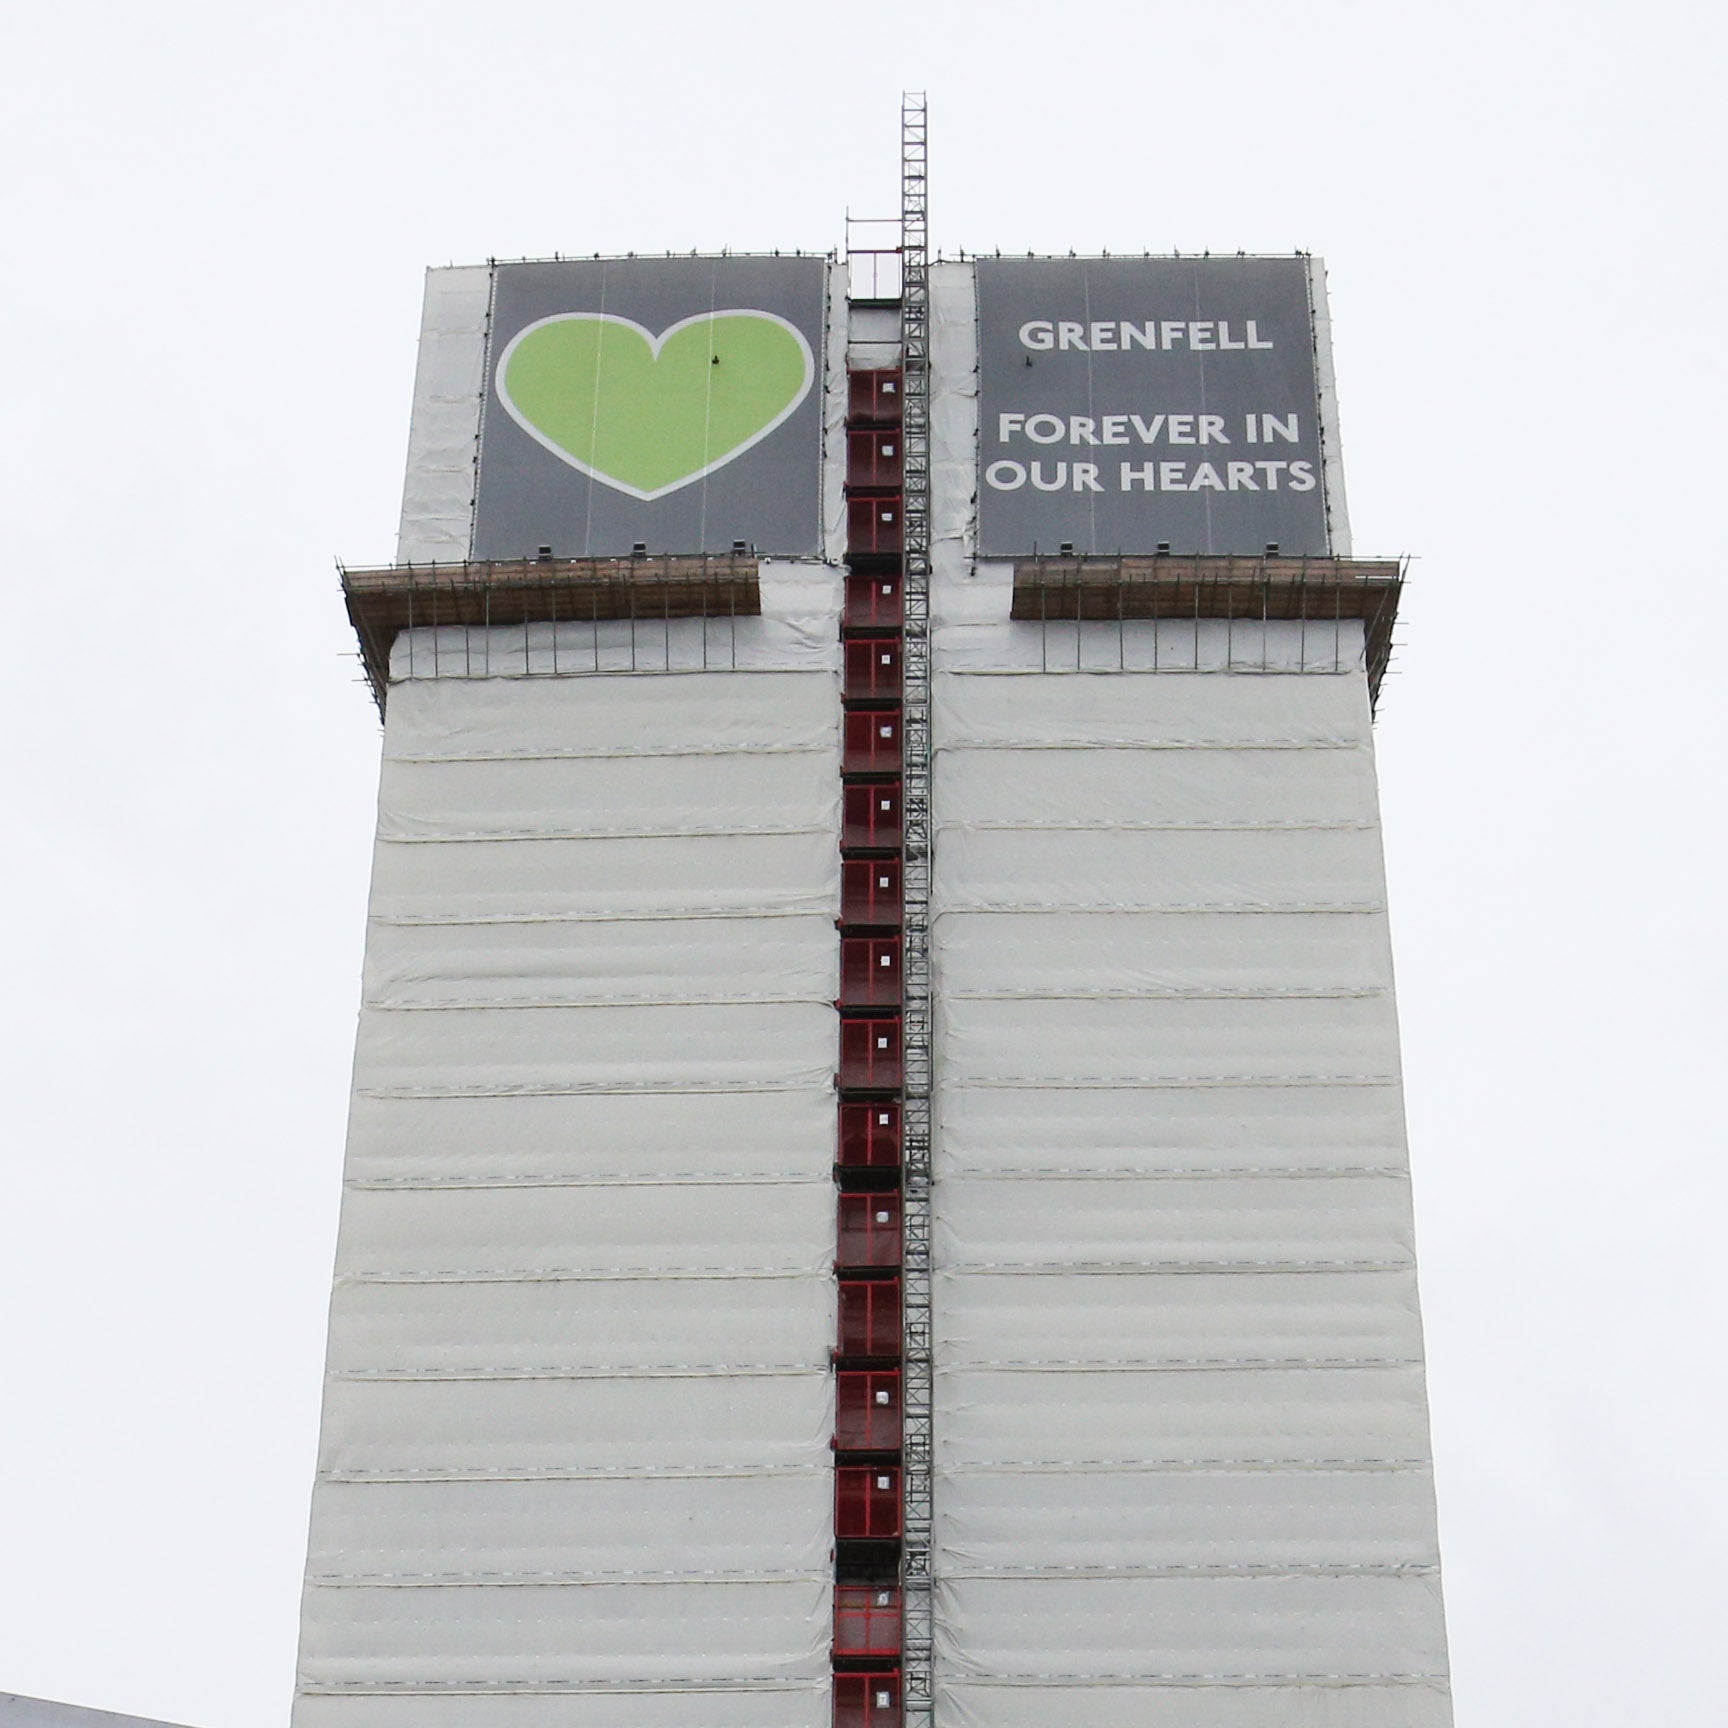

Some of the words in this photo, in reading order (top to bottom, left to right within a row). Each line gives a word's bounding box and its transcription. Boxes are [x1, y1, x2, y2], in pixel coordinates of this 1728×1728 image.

[1018, 319, 1274, 351] GRENFELL
[998, 412, 1231, 445] FOREVER
[1246, 412, 1300, 444] IN
[985, 459, 1105, 492] OUR
[1120, 460, 1317, 492] HEARTS
